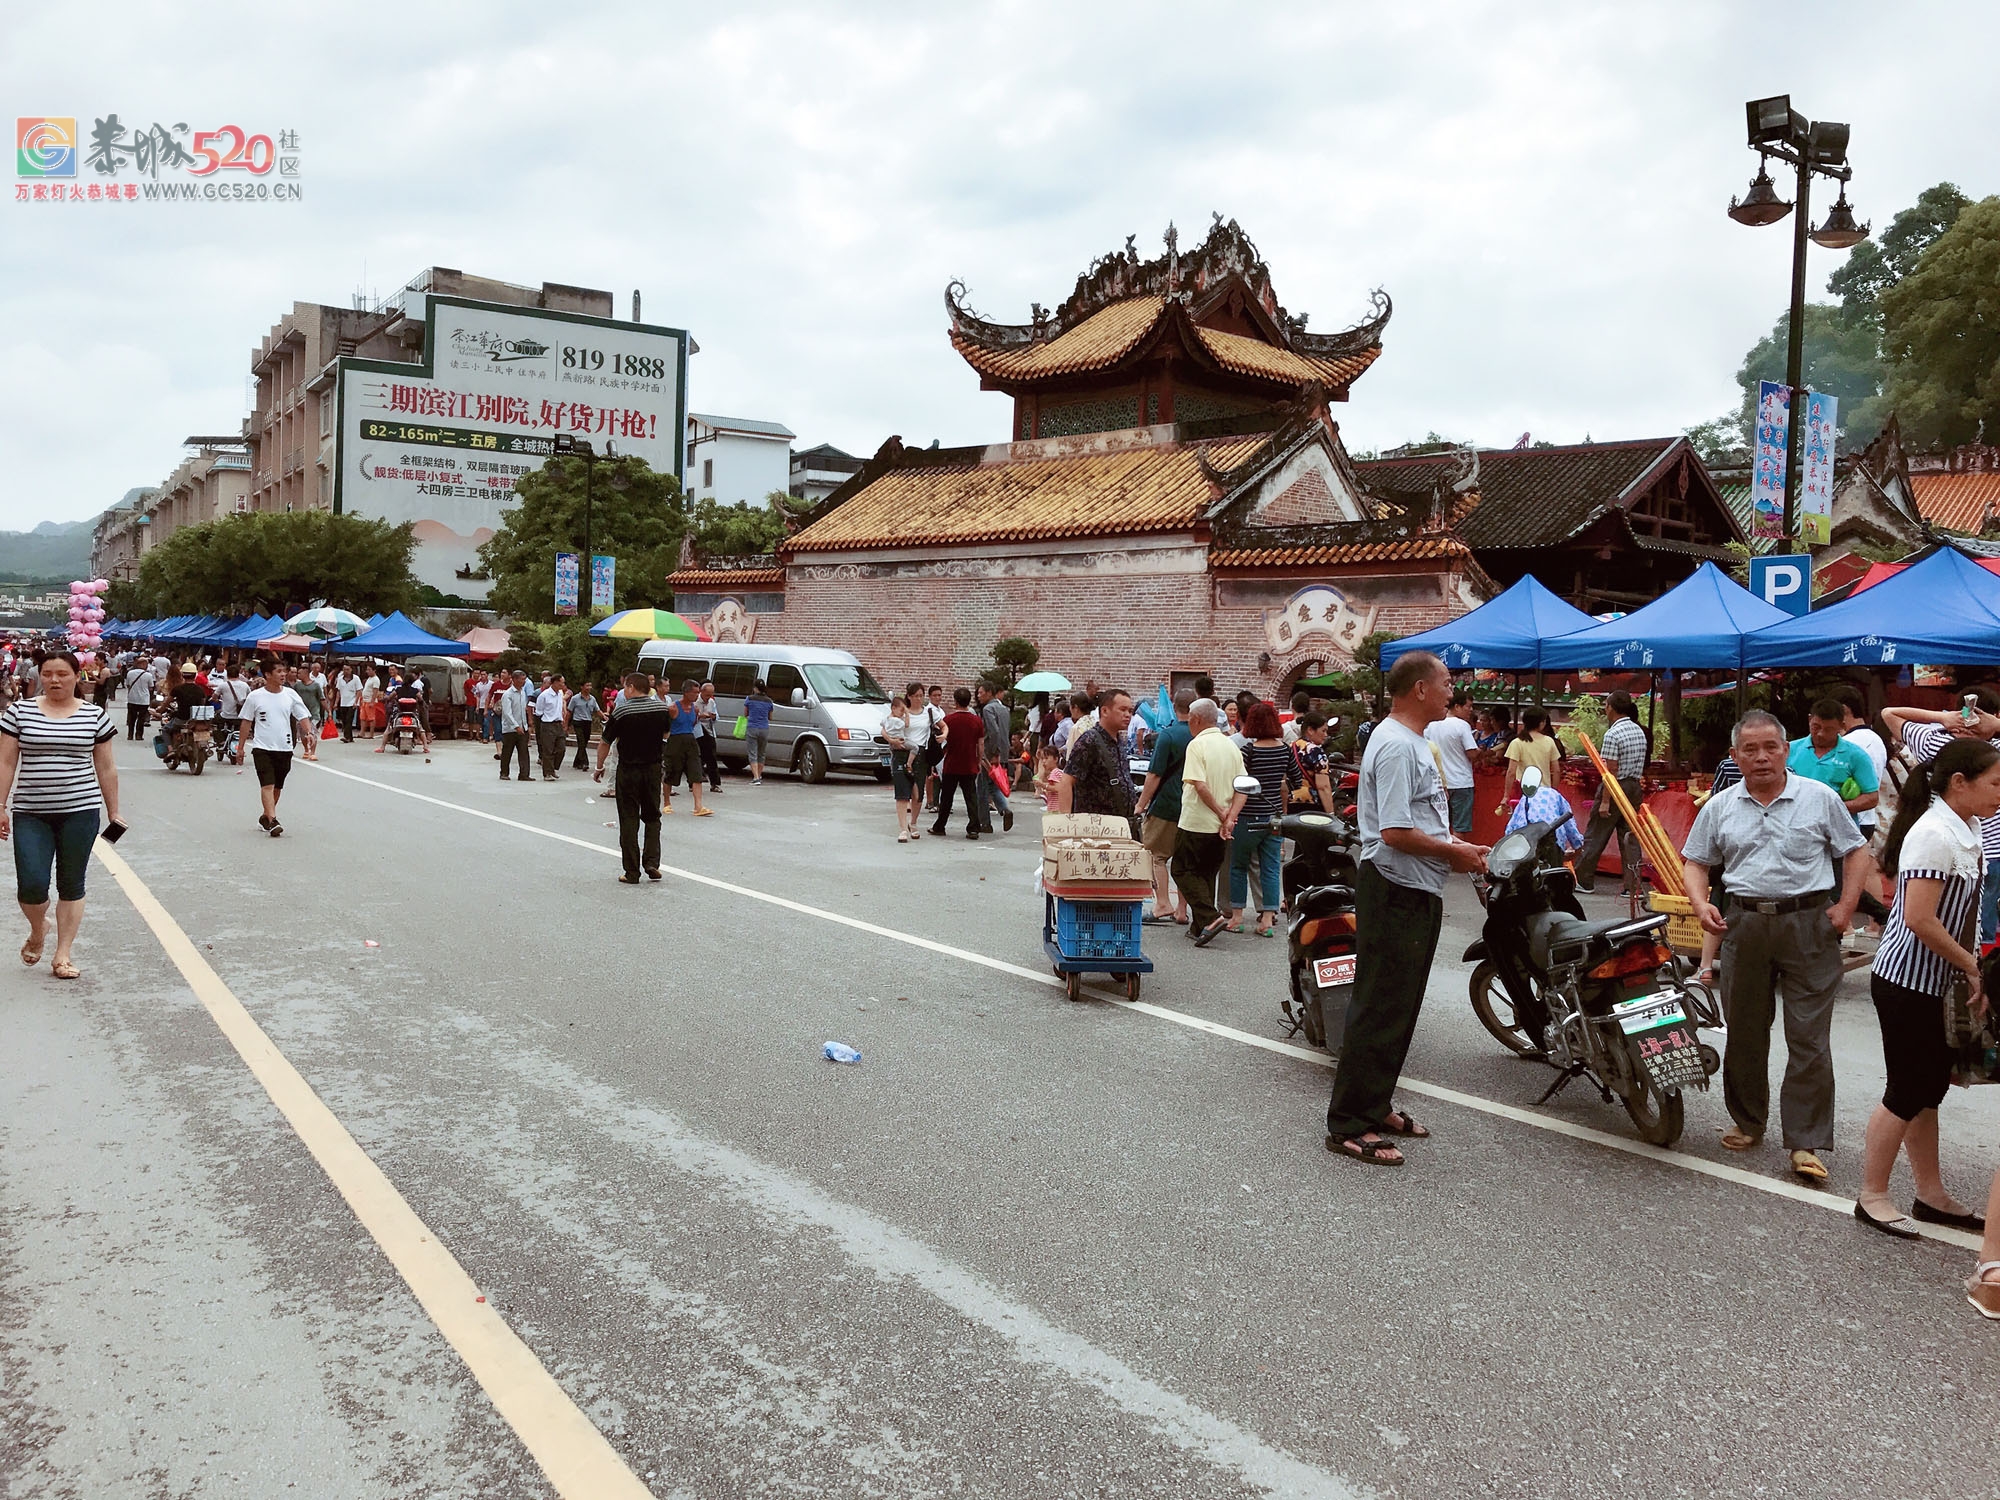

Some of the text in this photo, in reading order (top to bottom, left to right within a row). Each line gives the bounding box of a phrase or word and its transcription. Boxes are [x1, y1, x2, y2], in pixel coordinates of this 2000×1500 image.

[562, 346, 665, 379] 819 1888
[416, 483, 514, 502] 大四房三卫电梯房
[1765, 565, 1802, 605] P
[1069, 864, 1132, 879] 止咳化痰
[1637, 1028, 1697, 1059] 上海一家人
